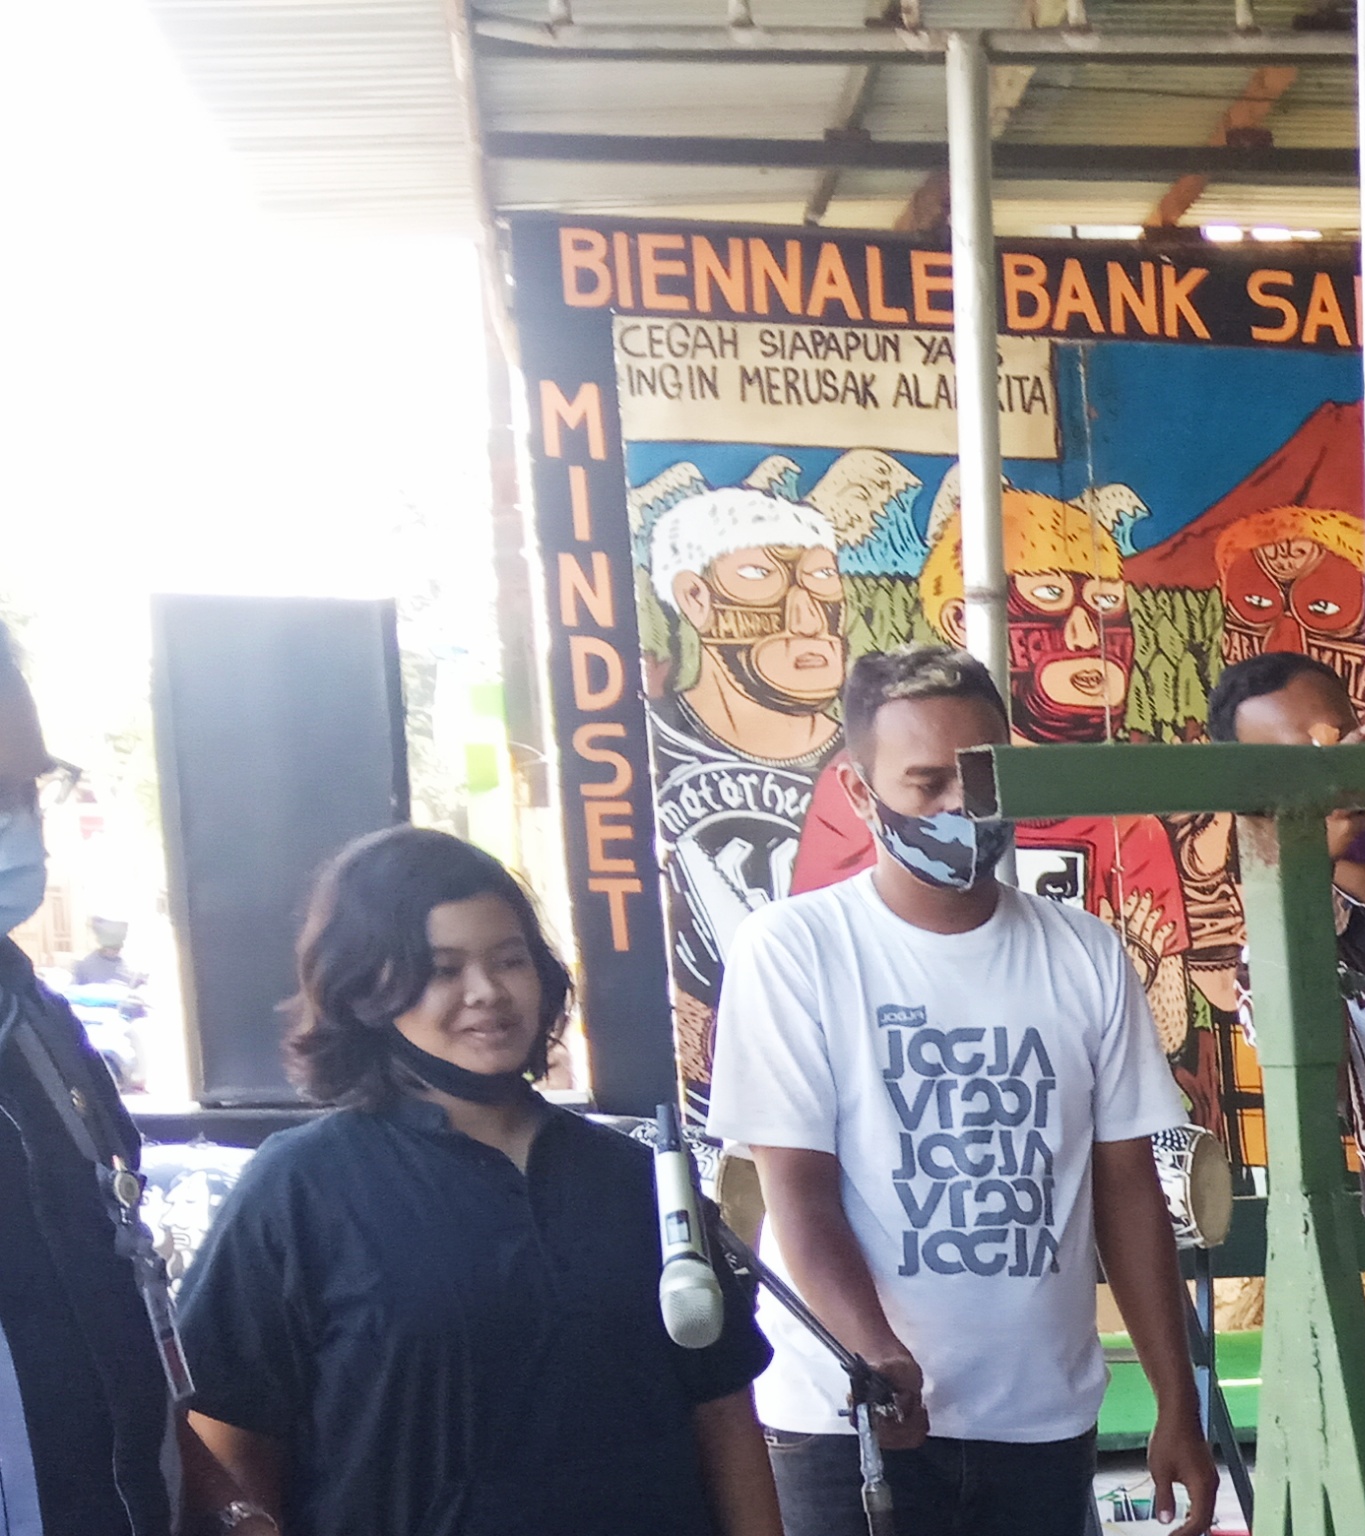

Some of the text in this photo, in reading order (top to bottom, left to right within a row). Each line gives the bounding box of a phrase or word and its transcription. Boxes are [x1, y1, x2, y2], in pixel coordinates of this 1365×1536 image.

[558, 226, 952, 326] BIENNALE
[1002, 253, 1211, 340] BANK
[619, 322, 739, 360] CEGAH
[759, 328, 901, 362] SIAPAPUN
[626, 363, 1049, 415] INGIN MERUSAK ALA ITA
[539, 380, 644, 952] MINDSET
